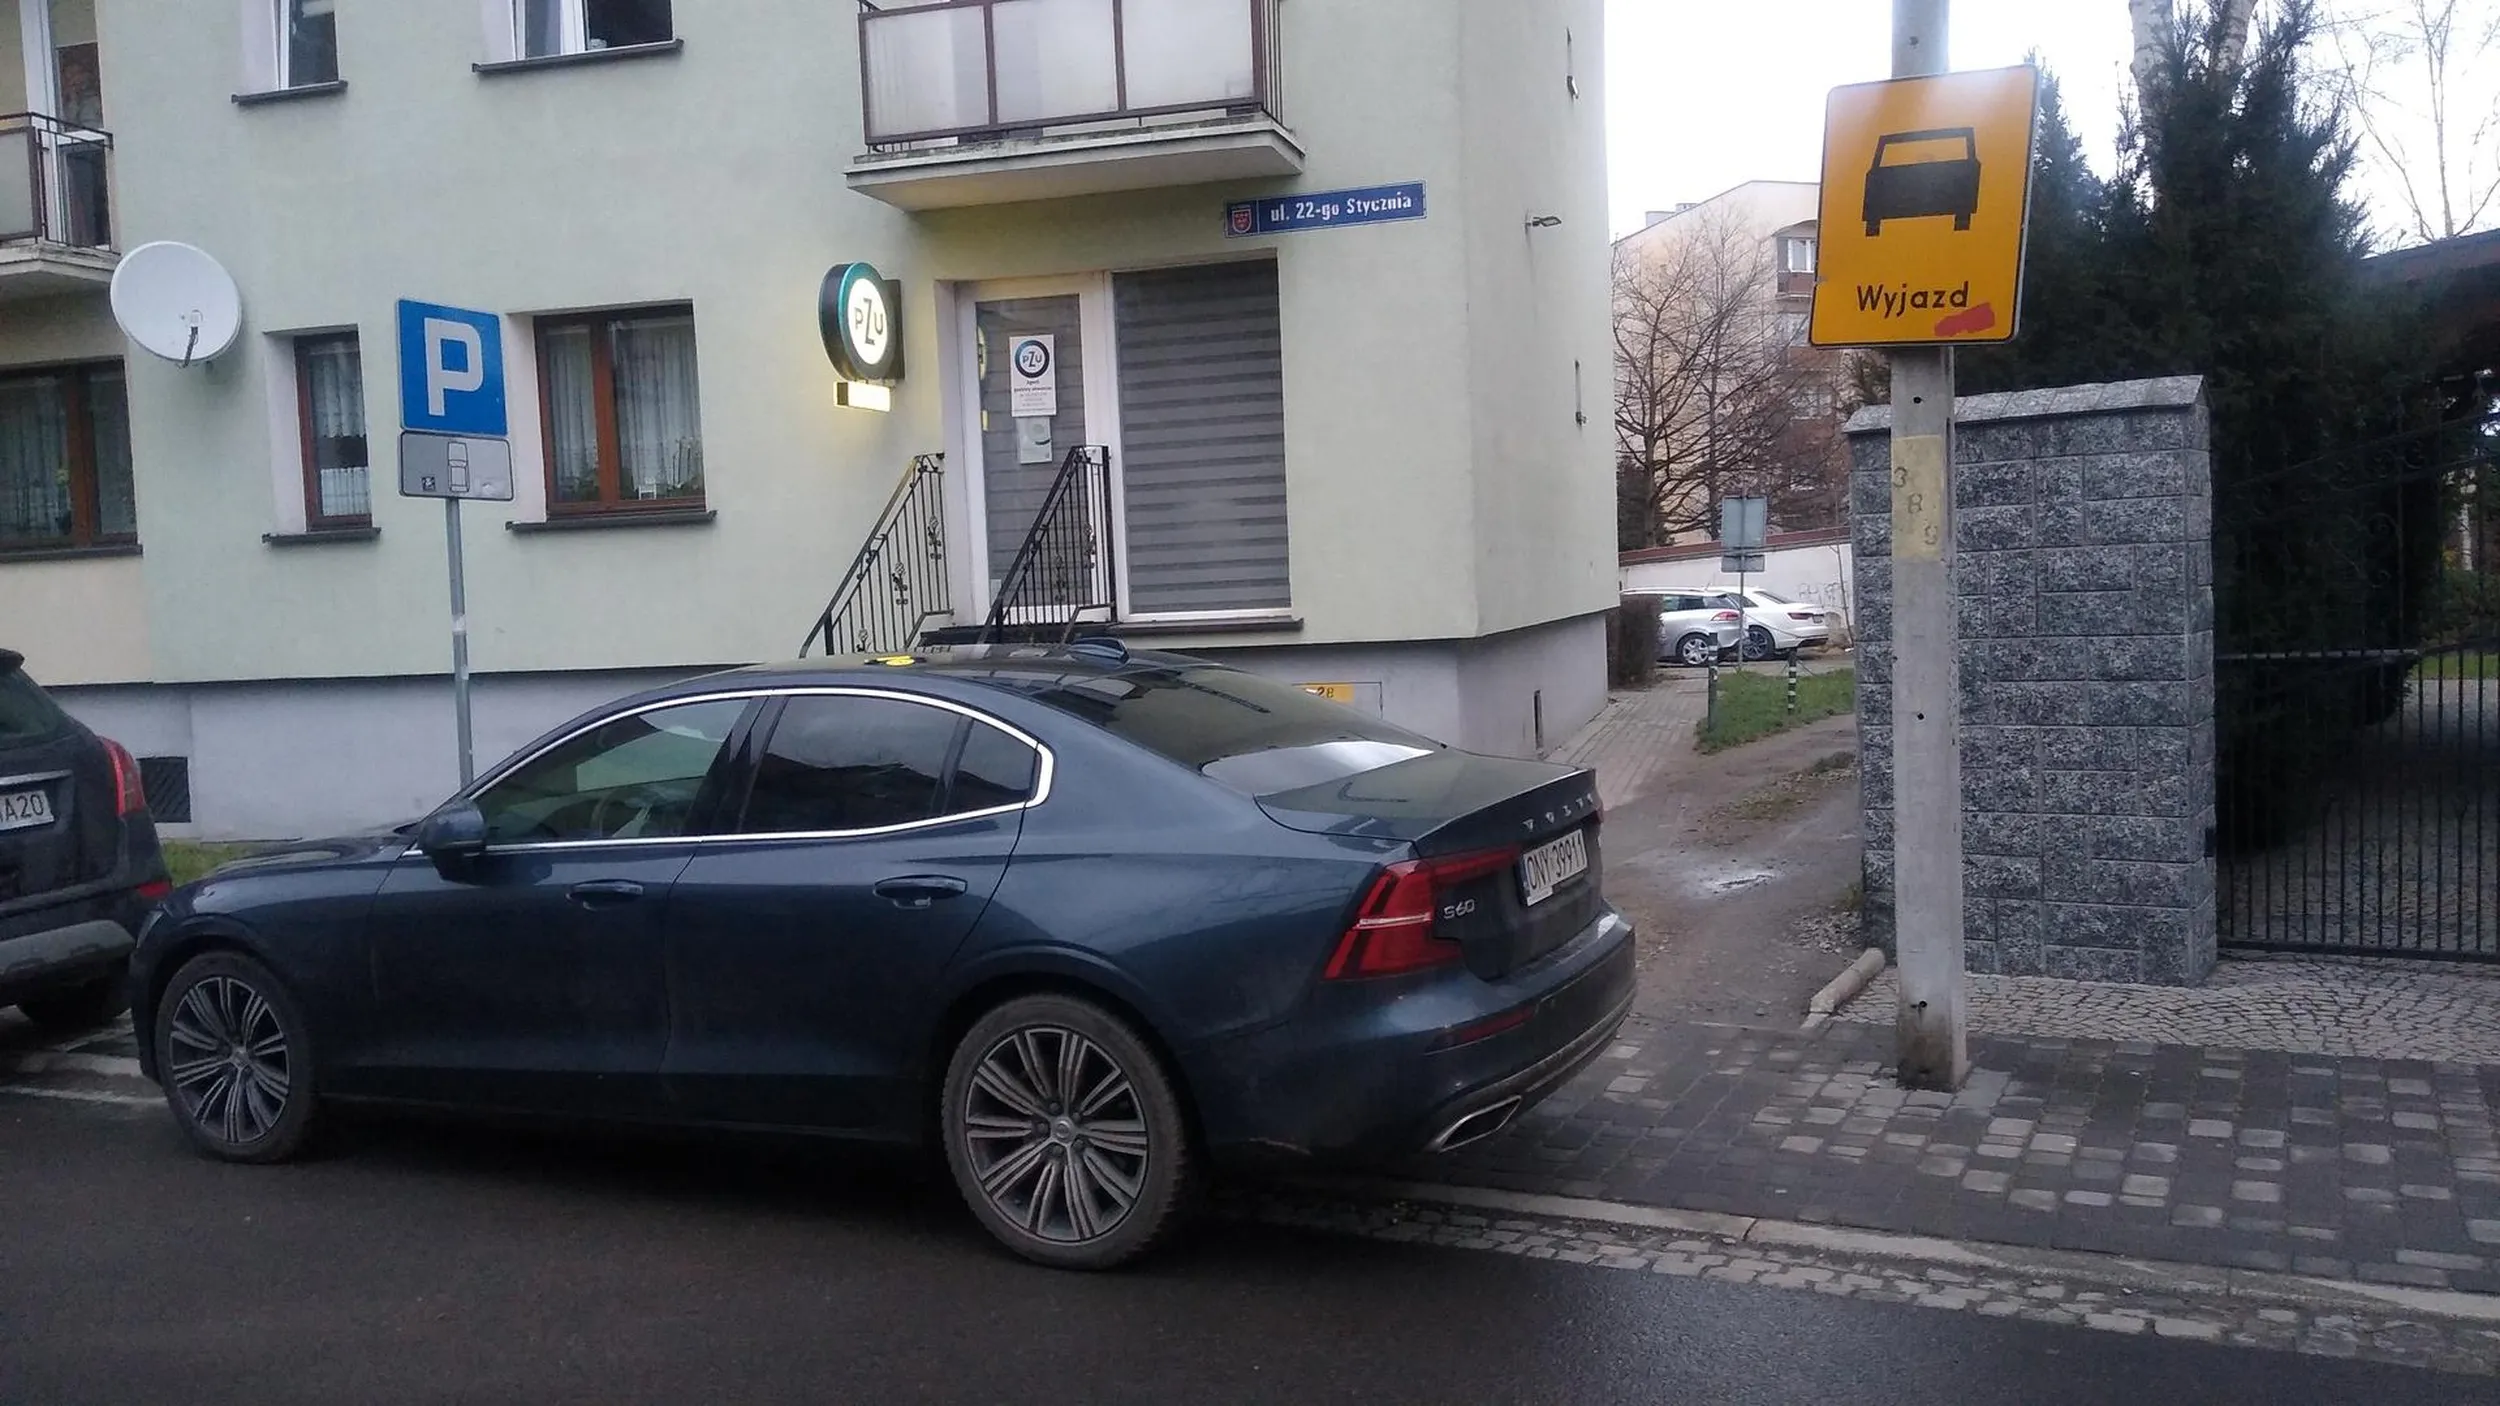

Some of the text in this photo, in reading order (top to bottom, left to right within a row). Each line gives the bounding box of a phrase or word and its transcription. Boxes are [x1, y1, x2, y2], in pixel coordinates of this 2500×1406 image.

[1270, 191, 1412, 222] ul. 22-go Stycznia
[1856, 281, 1969, 319] Wyjazd
[853, 297, 884, 346] PZU
[424, 317, 484, 416] P
[1022, 351, 1043, 368] PZU
[0, 794, 44, 822] A20
[1552, 833, 1585, 878] 39911
[1443, 898, 1475, 920] S60
